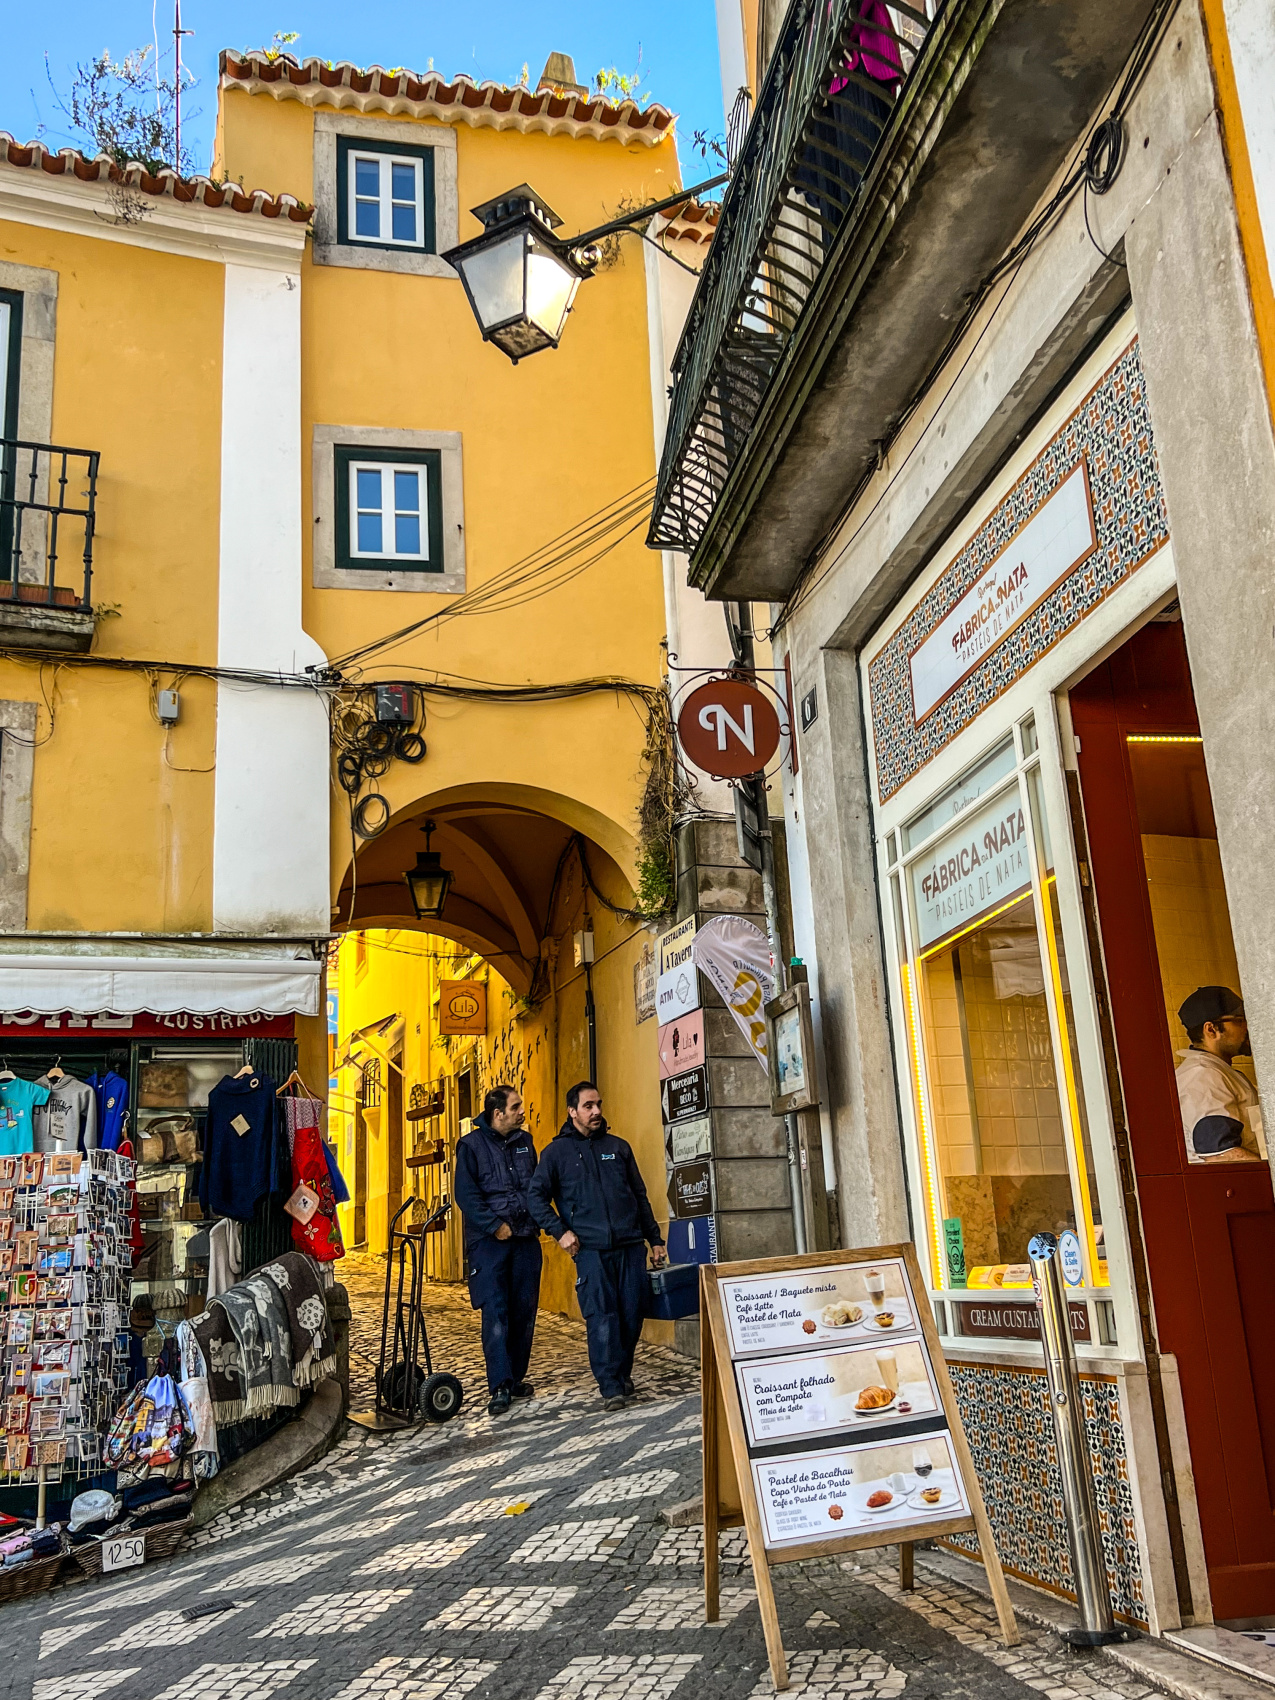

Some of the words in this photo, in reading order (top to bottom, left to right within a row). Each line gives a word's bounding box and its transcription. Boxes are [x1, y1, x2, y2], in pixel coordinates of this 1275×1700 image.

[952, 597, 995, 653] FÁBRICA
[996, 562, 1028, 605] NATA
[962, 626, 991, 663] PASTÉIS
[993, 613, 1003, 637] DE
[1005, 591, 1024, 621] NATA
[805, 696, 811, 722] 6
[698, 703, 755, 757] N
[921, 842, 982, 902] FÁBRICA
[983, 808, 1025, 859] NATA
[935, 884, 975, 921] PASTÉIS
[978, 871, 992, 900] DE
[996, 850, 1023, 886] NATA
[663, 919, 694, 947] RESTAURANTE
[666, 954, 670, 970] A
[670, 944, 692, 968] Tavern
[454, 999, 474, 1014] Lila
[660, 988, 674, 1005] ATM
[671, 1072, 699, 1092] Mercearia
[707, 1215, 718, 1264] STAURANTE
[1064, 1250, 1076, 1258] Clean
[1065, 1258, 1068, 1266] &
[1069, 1257, 1078, 1266] Safe
[734, 1289, 773, 1302] Croissant
[774, 1289, 778, 1298] /
[780, 1285, 814, 1299] Baguete
[814, 1282, 837, 1293] mista
[736, 1303, 753, 1314] Café
[754, 1302, 774, 1312] Latte
[737, 1312, 766, 1324] Pastel
[767, 1311, 778, 1320] de
[779, 1308, 802, 1318] Nata
[970, 1309, 1002, 1327] CREAM
[1003, 1310, 1040, 1328] CUSTAR
[754, 1379, 798, 1394] Croissant
[799, 1374, 836, 1391] folhado
[756, 1397, 774, 1406] com
[775, 1390, 813, 1404] Compota
[758, 1406, 777, 1416] Meia
[778, 1405, 786, 1413] de
[787, 1403, 803, 1413] Leite
[768, 1473, 800, 1487] Pastel
[800, 1472, 810, 1482] de
[811, 1467, 854, 1481] Bacalhau
[770, 1488, 790, 1499] Copo
[790, 1483, 816, 1494] Vinho
[816, 1481, 827, 1490] do
[827, 1478, 851, 1489] Porto
[772, 1498, 789, 1509] Café
[793, 1494, 818, 1505] Pastel
[818, 1492, 827, 1500] de
[828, 1489, 847, 1499] Nata
